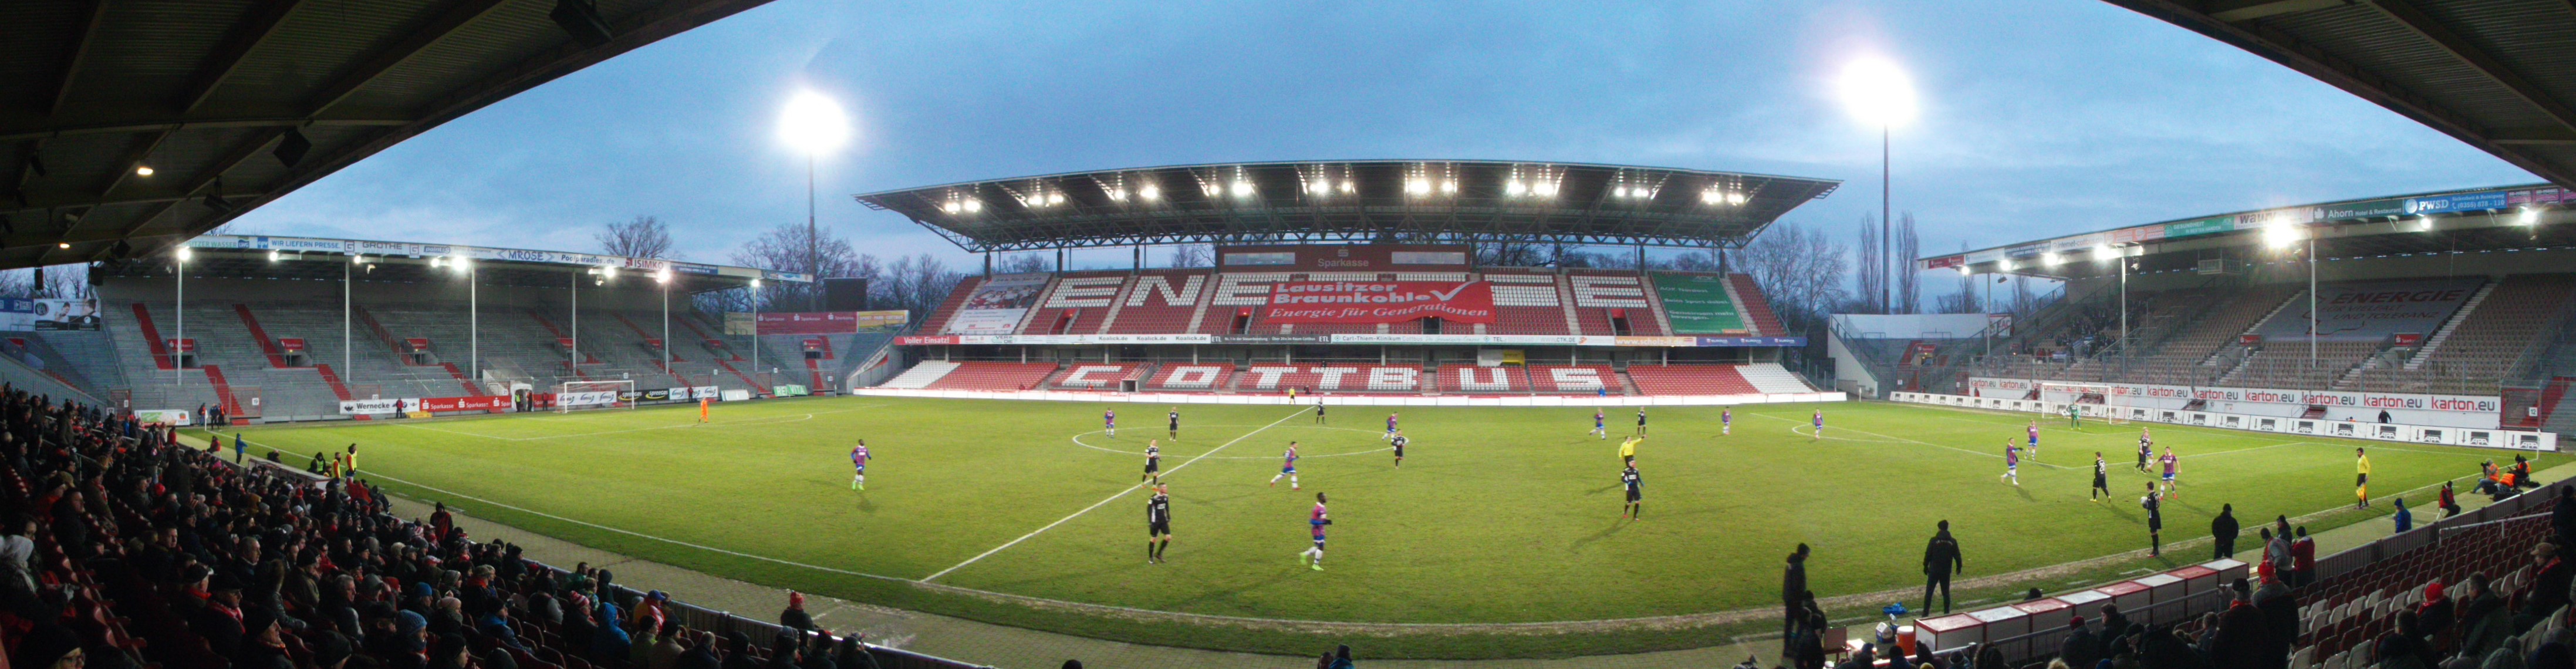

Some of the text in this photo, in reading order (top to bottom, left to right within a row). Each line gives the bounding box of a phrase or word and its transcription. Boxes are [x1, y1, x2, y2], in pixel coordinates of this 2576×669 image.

[2419, 199, 2449, 211] PWSD
[2327, 210, 2353, 218] Ahorn
[2173, 221, 2204, 230] GESUNDHEIT
[362, 241, 403, 251] GROTHE
[508, 250, 544, 261] MROSE
[561, 254, 615, 264] Poolparadies.de
[634, 259, 664, 270] ISIMKO
[1318, 258, 1369, 268] Sparkasse
[1276, 281, 1397, 293] Lausitzer
[1273, 293, 1431, 304] Braunkohle
[2329, 289, 2466, 305] ENERGIE
[1269, 302, 1488, 318] Energie für Generationen
[2368, 311, 2440, 320] TOLERANZ
[1970, 379, 1996, 388] karton.eu
[2000, 380, 2028, 389] karton.eu
[789, 385, 805, 395] VITA
[2147, 385, 2188, 398] karton.eu
[2193, 386, 2239, 400] karton.eu
[2245, 389, 2294, 403] karton.eu
[2301, 391, 2355, 405] karton.eu
[2364, 394, 2422, 409] karton.eu
[2432, 396, 2495, 411] karton.eu
